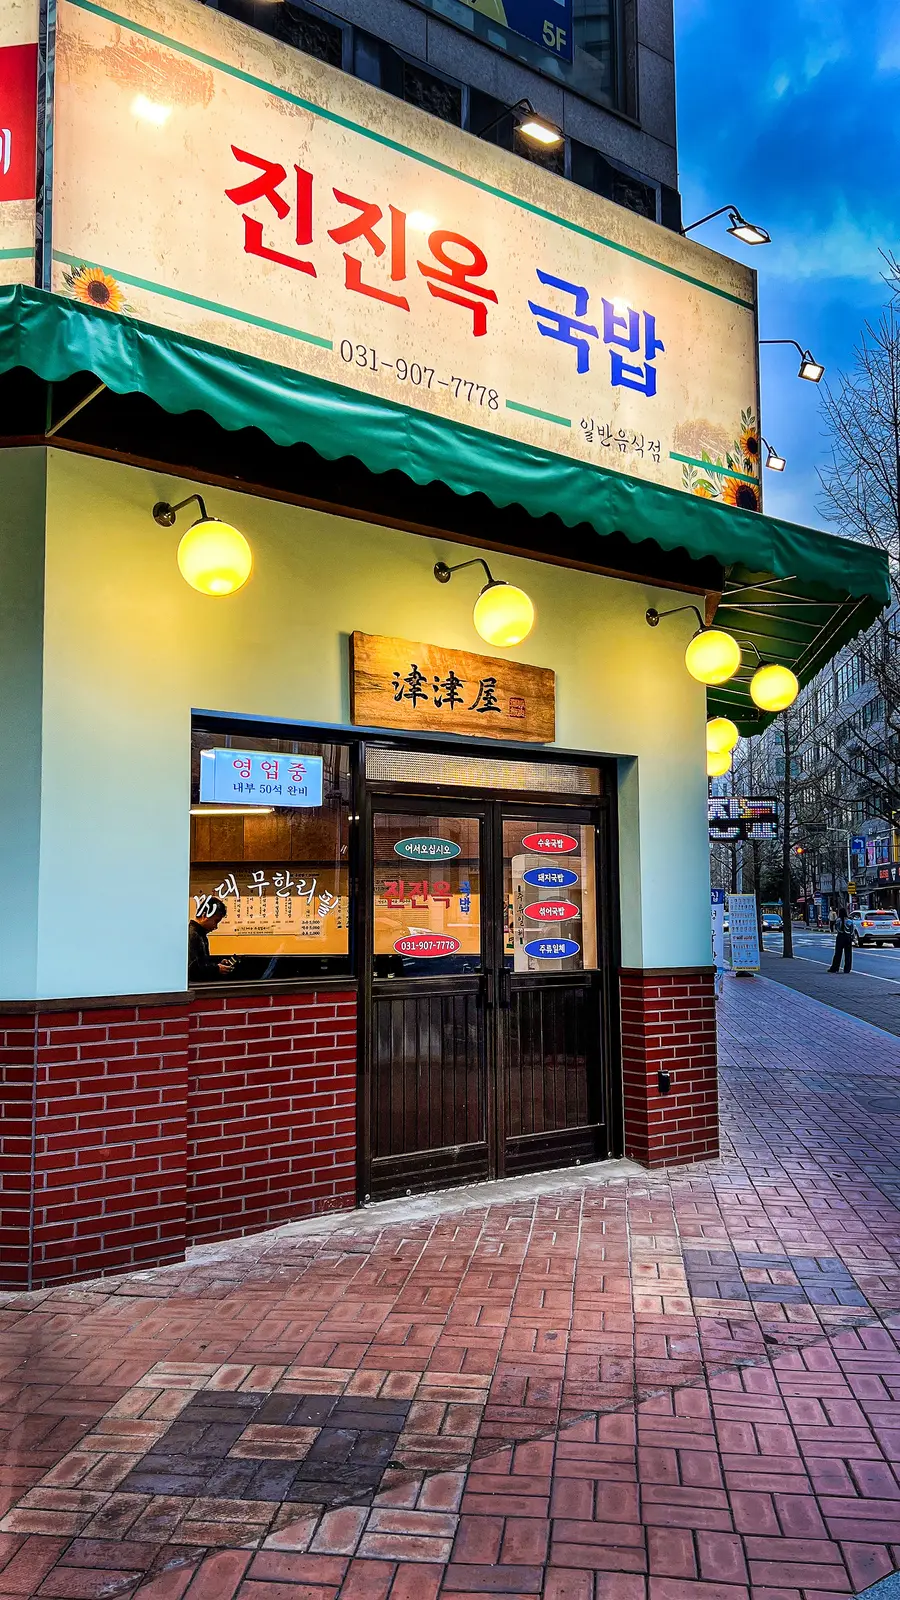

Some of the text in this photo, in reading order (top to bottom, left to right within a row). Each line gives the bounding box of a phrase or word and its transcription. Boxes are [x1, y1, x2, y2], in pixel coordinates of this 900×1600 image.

[542, 20, 567, 51] 5F
[224, 144, 665, 397] 진진옥 국밥
[340, 339, 499, 410] 031-907-7778
[580, 418, 661, 463] 일반음식점
[391, 663, 502, 713] 津津屋
[233, 782, 308, 797] 내부 50석 완비
[405, 843, 451, 855] 어서오십시오
[537, 838, 565, 849] 수육국밥
[537, 873, 565, 883] 돼지국밥
[383, 880, 453, 910] 진진옥
[458, 881, 471, 913] 국밥
[538, 906, 565, 917] 섞어국밥
[401, 940, 456, 951] 031-907-7778
[539, 943, 566, 954] 주류일체
